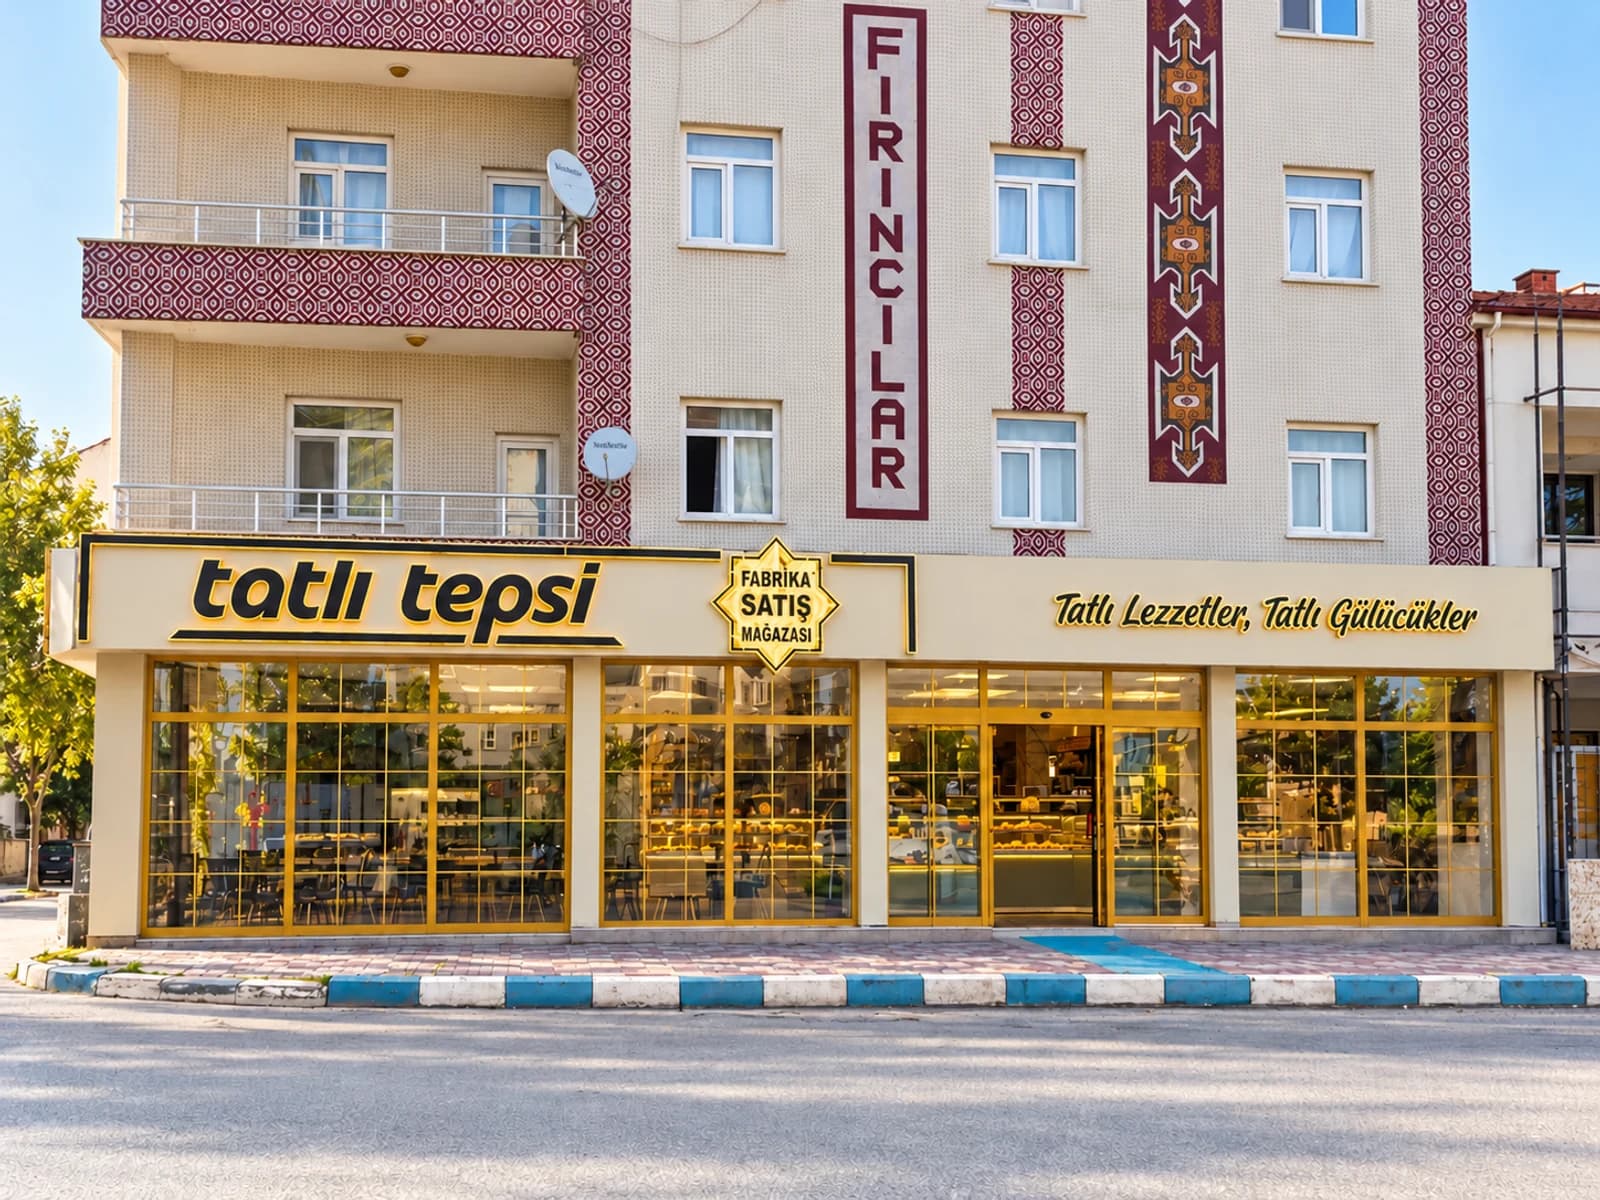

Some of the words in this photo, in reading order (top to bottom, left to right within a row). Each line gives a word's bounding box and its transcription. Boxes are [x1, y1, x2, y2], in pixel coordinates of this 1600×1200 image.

[867, 26, 906, 490] FIRINCILAR
[741, 567, 811, 588] FABRİKA
[193, 559, 373, 620] tatlı
[401, 562, 601, 644] tepsi
[741, 593, 812, 623] SATIŞ
[1056, 592, 1115, 625] Tatlı
[1121, 594, 1250, 632] Lezzetler,
[1264, 596, 1322, 628] Tatlı
[1330, 597, 1477, 636] Gülücükler
[741, 623, 812, 643] MAĞAZASI
